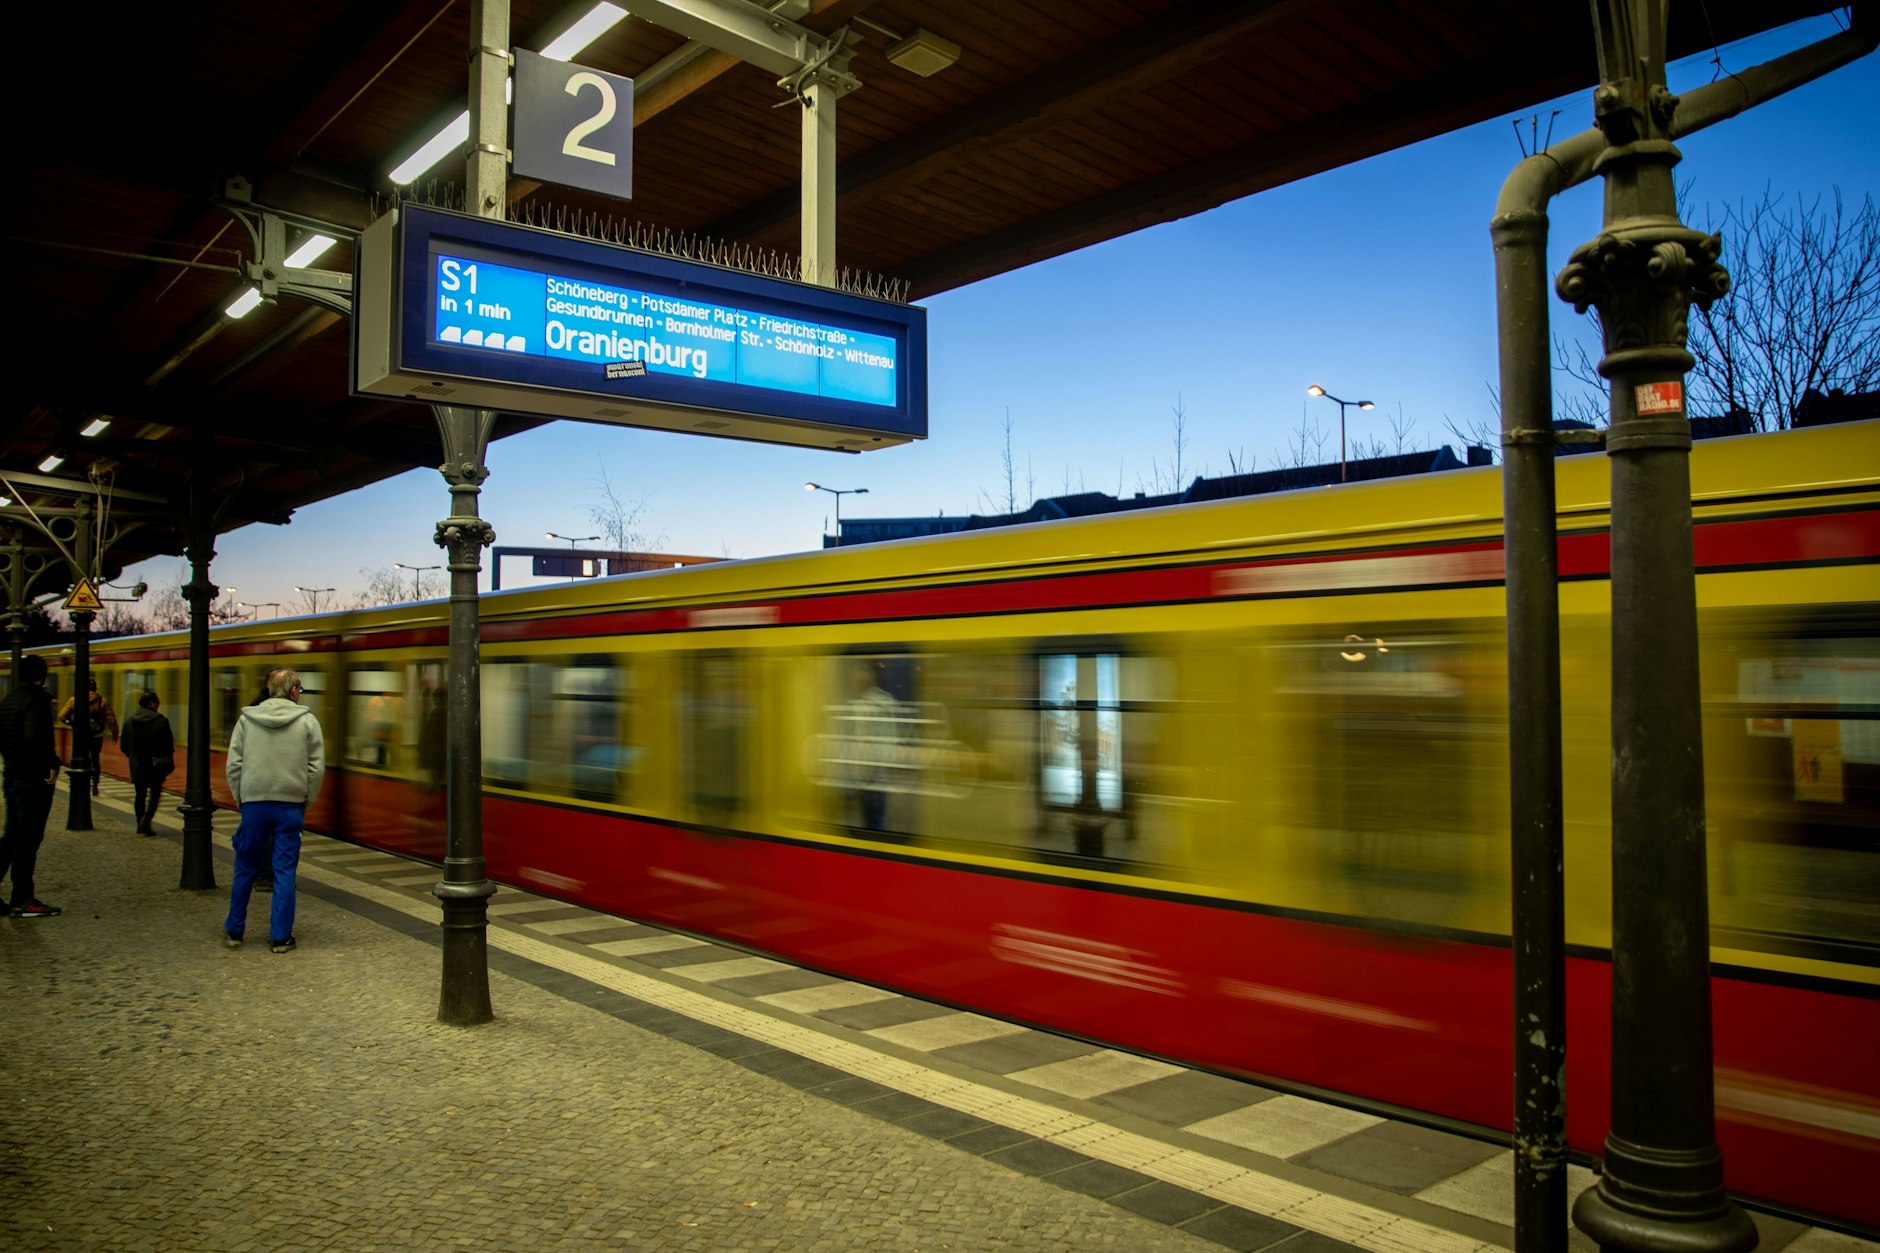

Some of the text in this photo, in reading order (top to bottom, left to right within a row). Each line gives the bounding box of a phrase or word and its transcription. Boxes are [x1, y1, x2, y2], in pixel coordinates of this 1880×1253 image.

[562, 71, 617, 167] 2
[440, 295, 511, 320] in 1 min
[441, 260, 477, 294] S1
[546, 278, 628, 310] Schöneberg
[641, 295, 711, 321] Potsdamer
[713, 308, 748, 328] Platz
[759, 316, 847, 345] Friedrichstraße
[546, 297, 653, 329] Gesundbrunnen
[665, 317, 737, 343] Bornholmer
[740, 330, 764, 347] Str.
[774, 336, 834, 359] Schönholz
[844, 348, 894, 369] Wittenau
[545, 320, 707, 379] Oranienburg
